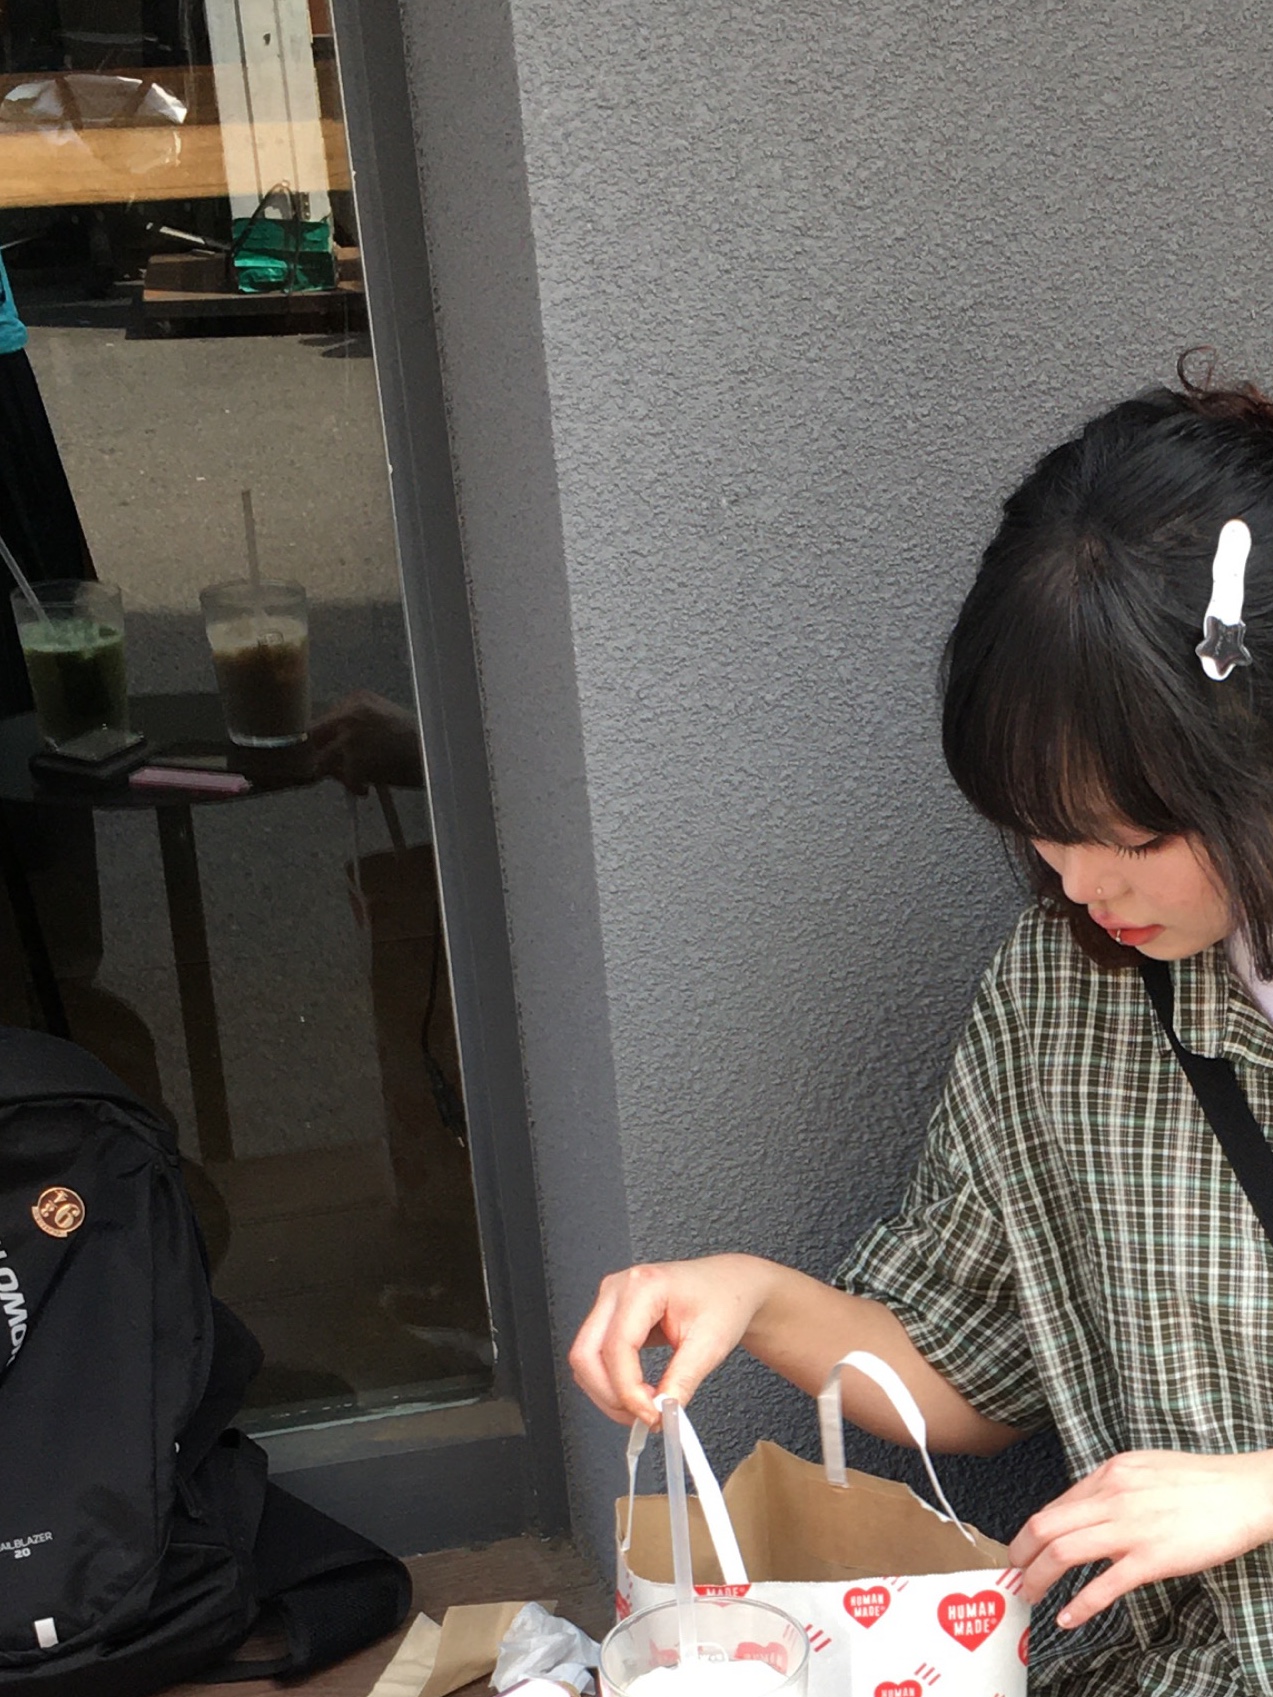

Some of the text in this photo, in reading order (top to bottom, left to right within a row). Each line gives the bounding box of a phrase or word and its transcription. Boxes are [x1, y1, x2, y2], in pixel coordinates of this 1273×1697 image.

[14, 1547, 31, 1559] 20
[850, 1593, 885, 1607] HUMAN
[947, 1601, 996, 1621] HUMAN
